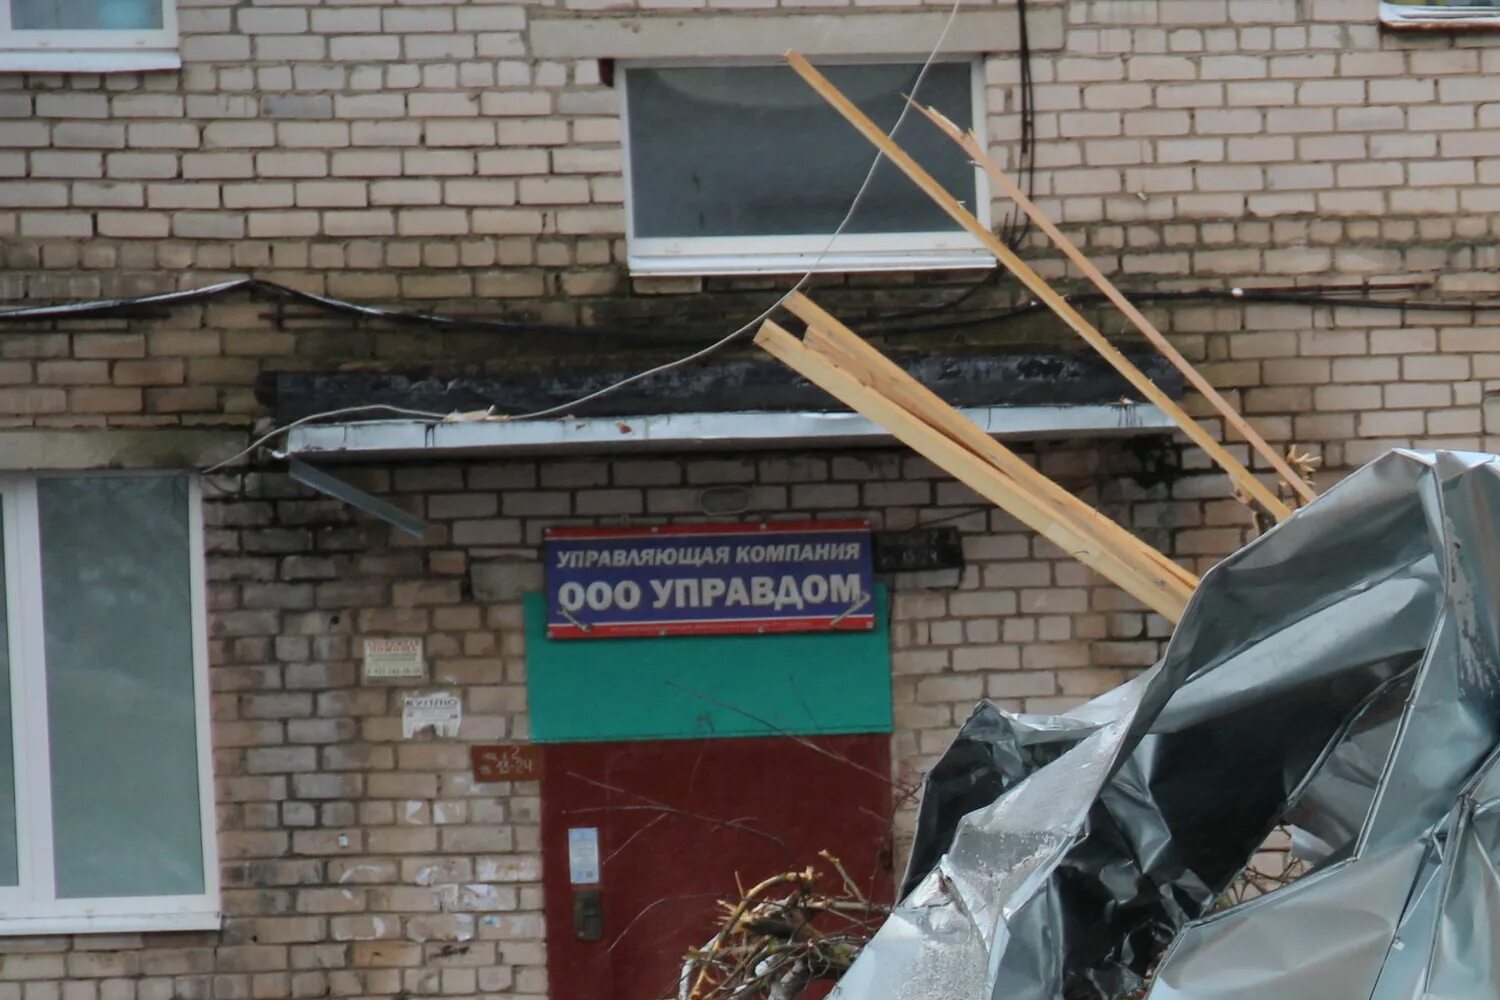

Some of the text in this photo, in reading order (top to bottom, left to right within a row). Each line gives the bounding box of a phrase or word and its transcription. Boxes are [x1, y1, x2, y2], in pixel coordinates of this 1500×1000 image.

[556, 545, 730, 569] УПРАВЛЯЮЩАЯ
[735, 542, 860, 565] КОМПАНИЯ
[558, 574, 862, 611] ООО УПРАВДОМ
